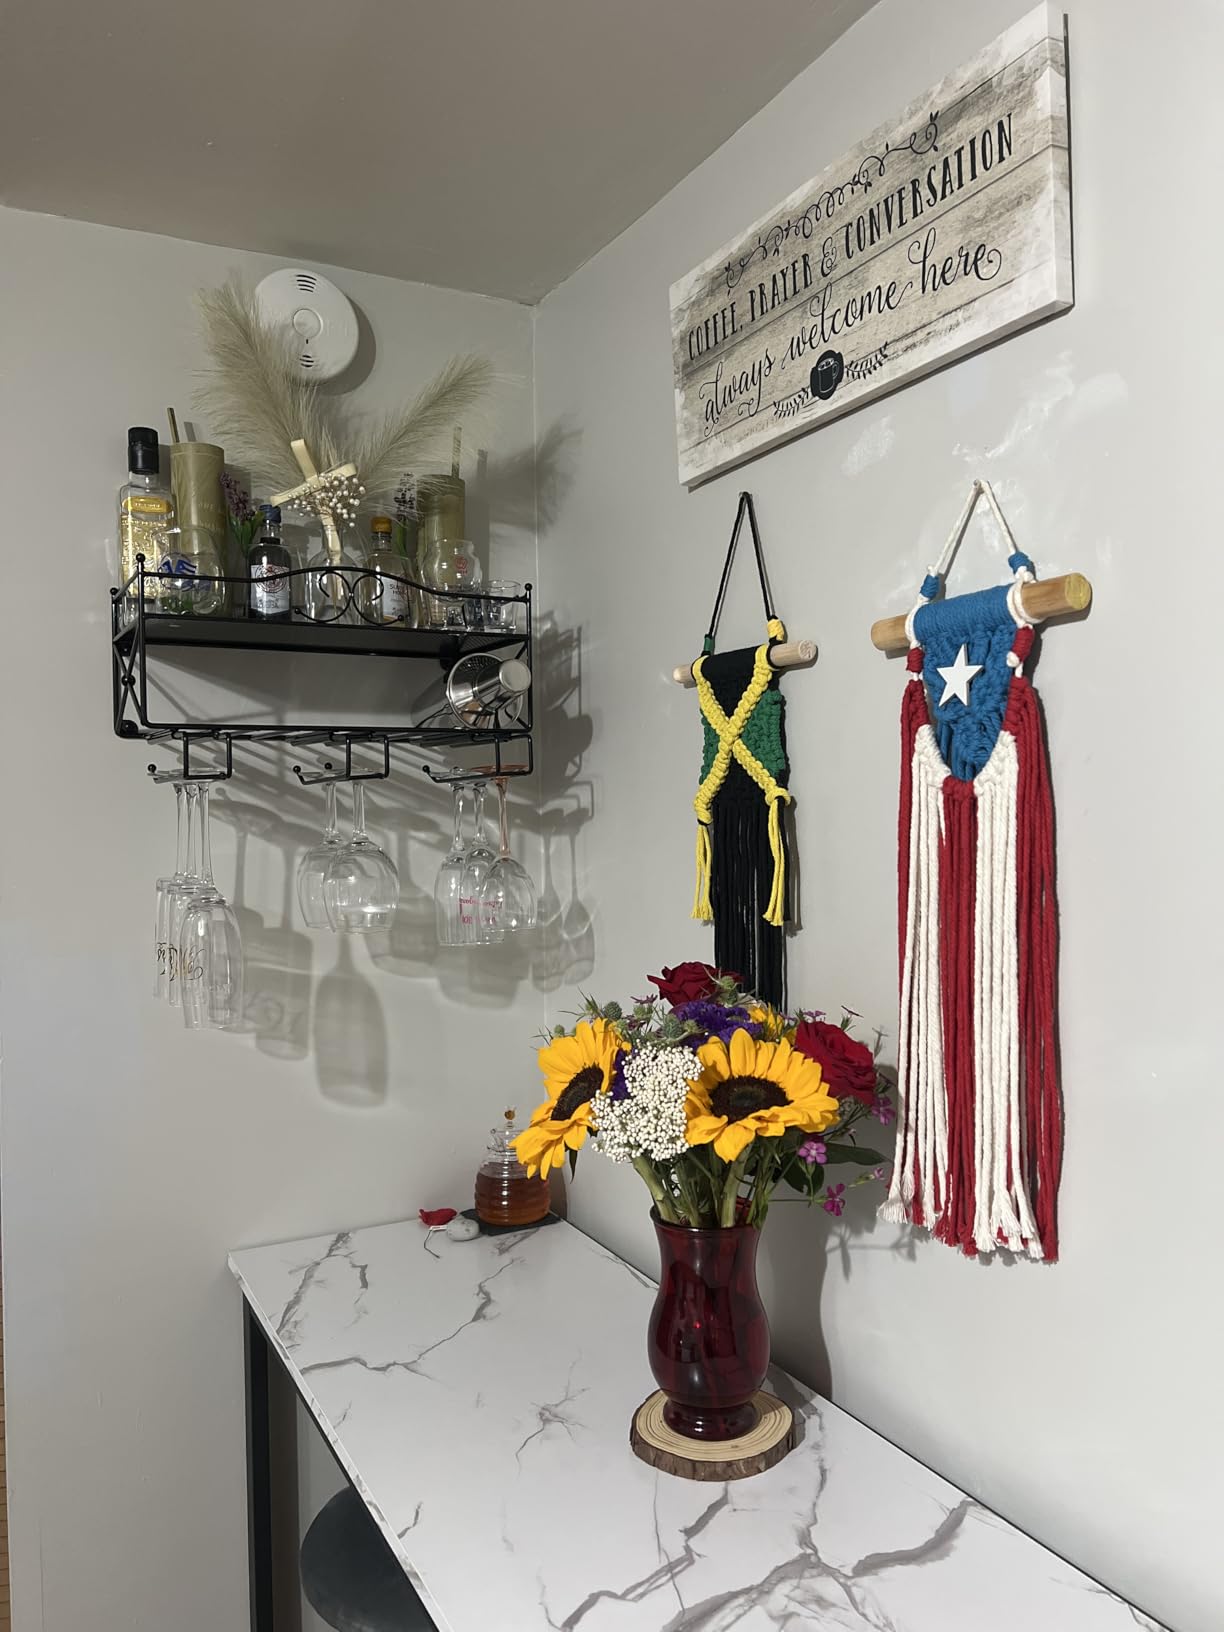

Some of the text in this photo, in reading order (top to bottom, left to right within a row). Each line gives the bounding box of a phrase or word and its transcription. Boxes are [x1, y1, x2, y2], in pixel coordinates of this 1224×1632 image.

[688, 113, 1013, 361] COFFEE, PRAYER & CONVERSATION
[699, 226, 1002, 438] always welcome here
